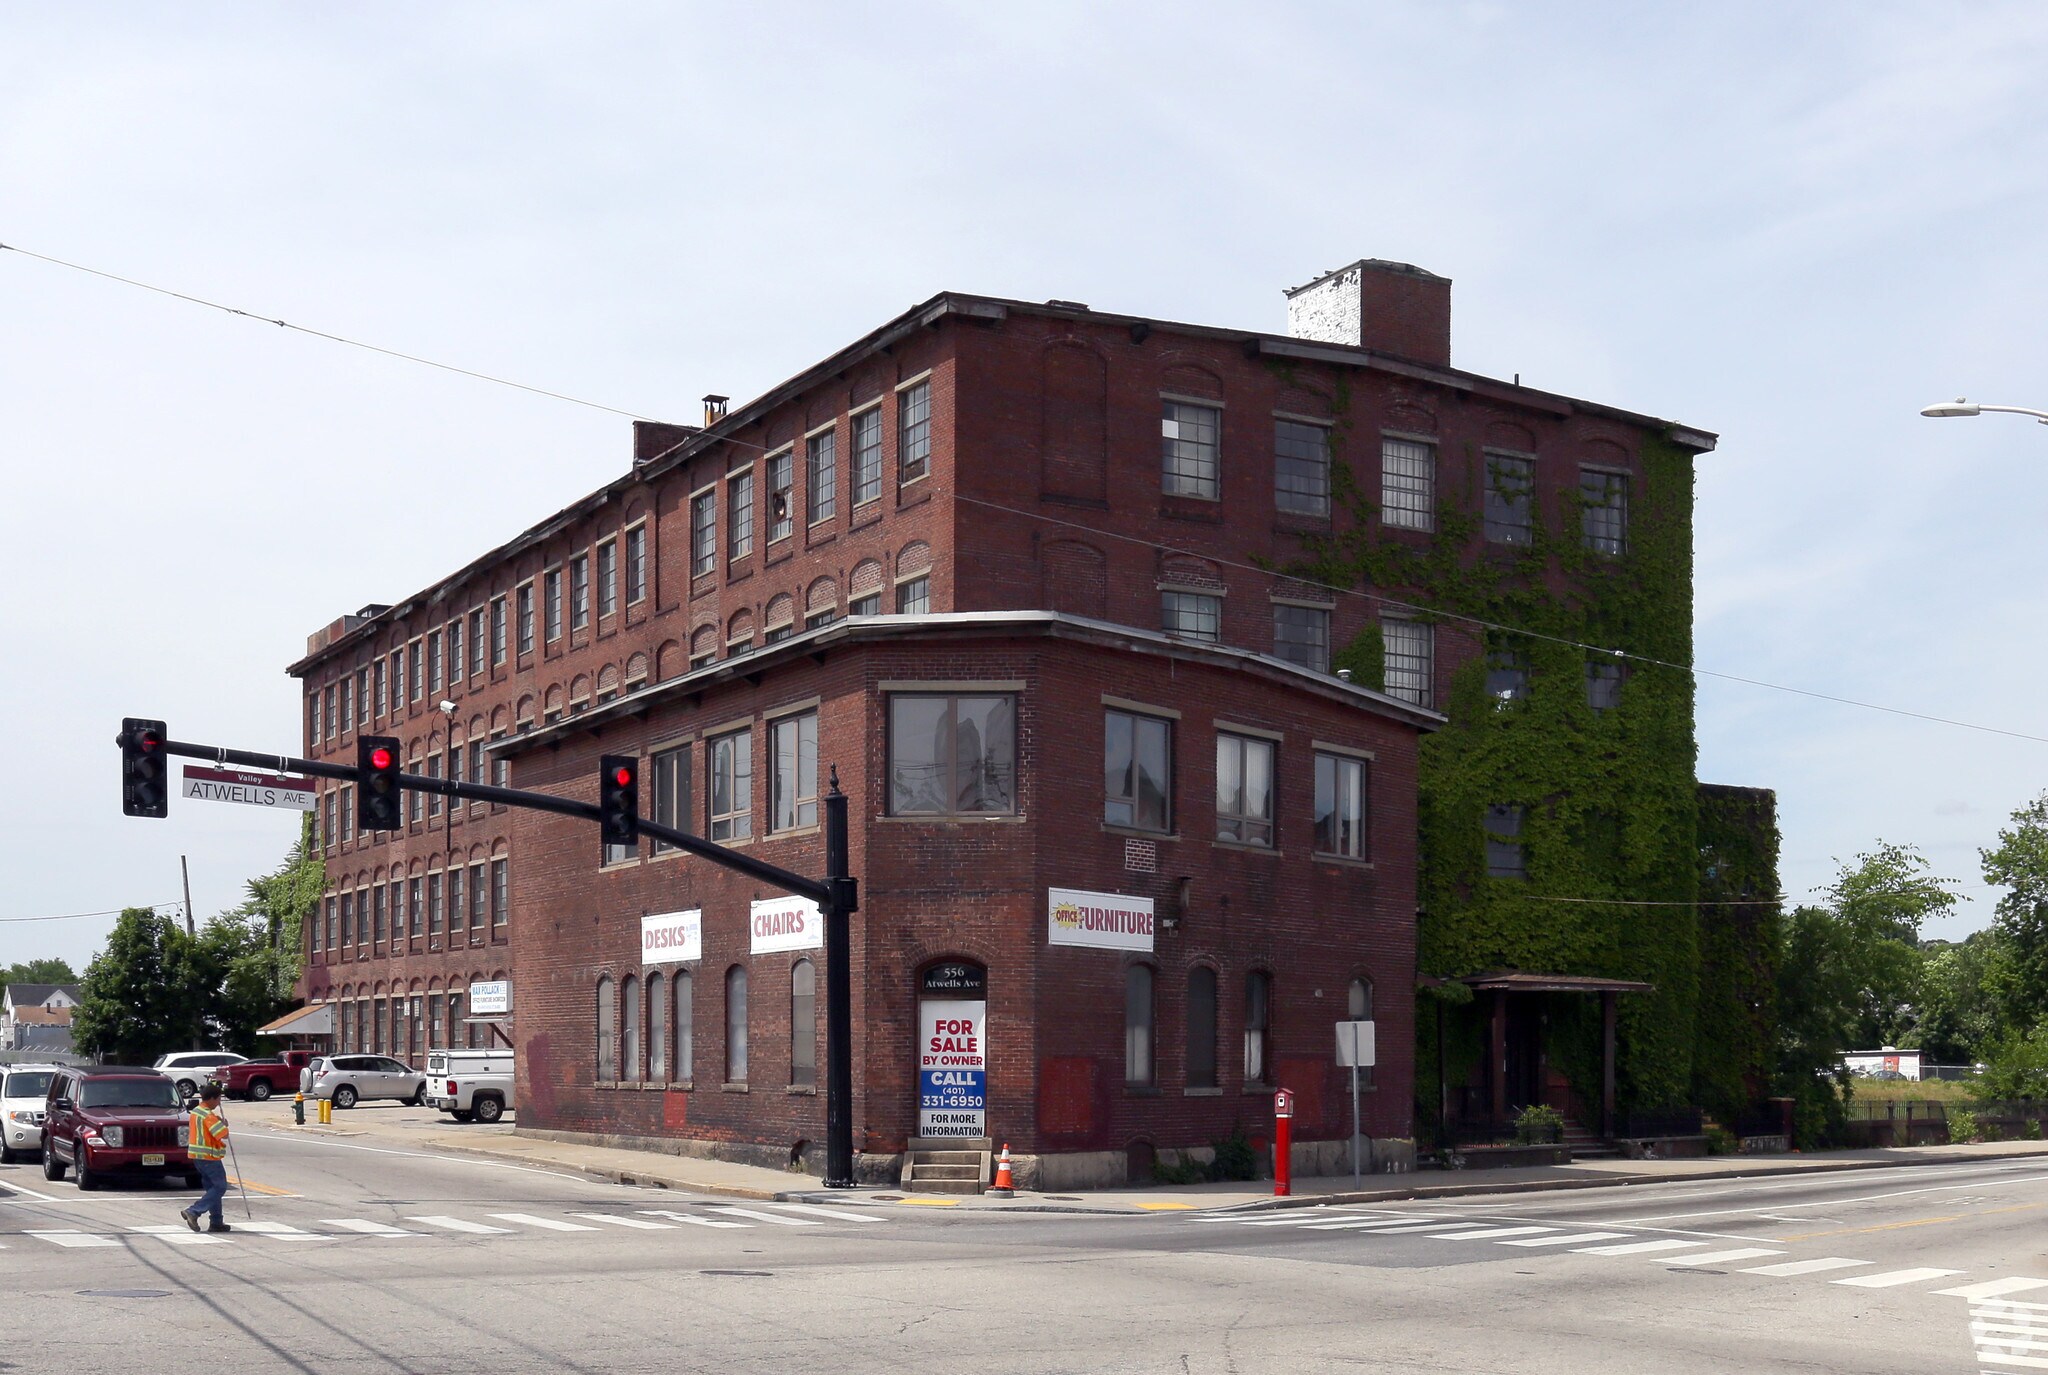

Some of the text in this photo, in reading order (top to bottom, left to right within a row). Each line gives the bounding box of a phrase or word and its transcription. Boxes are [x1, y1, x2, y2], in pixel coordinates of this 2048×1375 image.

[237, 773, 263, 784] Valley
[189, 782, 309, 805] ATWELLS AVE.
[753, 909, 804, 938] CHAIRS
[1056, 906, 1153, 935] OFFICE FURNITURE
[645, 925, 685, 950] DESKS
[944, 967, 965, 978] 556
[925, 979, 981, 988] Atwells Ave
[935, 1019, 973, 1035] FOR
[930, 1037, 978, 1053] SALE
[922, 1055, 983, 1066] BY OWNER
[930, 1071, 977, 1086] CALL
[942, 1087, 966, 1095] (401)
[922, 1095, 983, 1107] 331-6950
[931, 1114, 976, 1124] FOR MORE
[922, 1126, 983, 1136] INFORMATION
